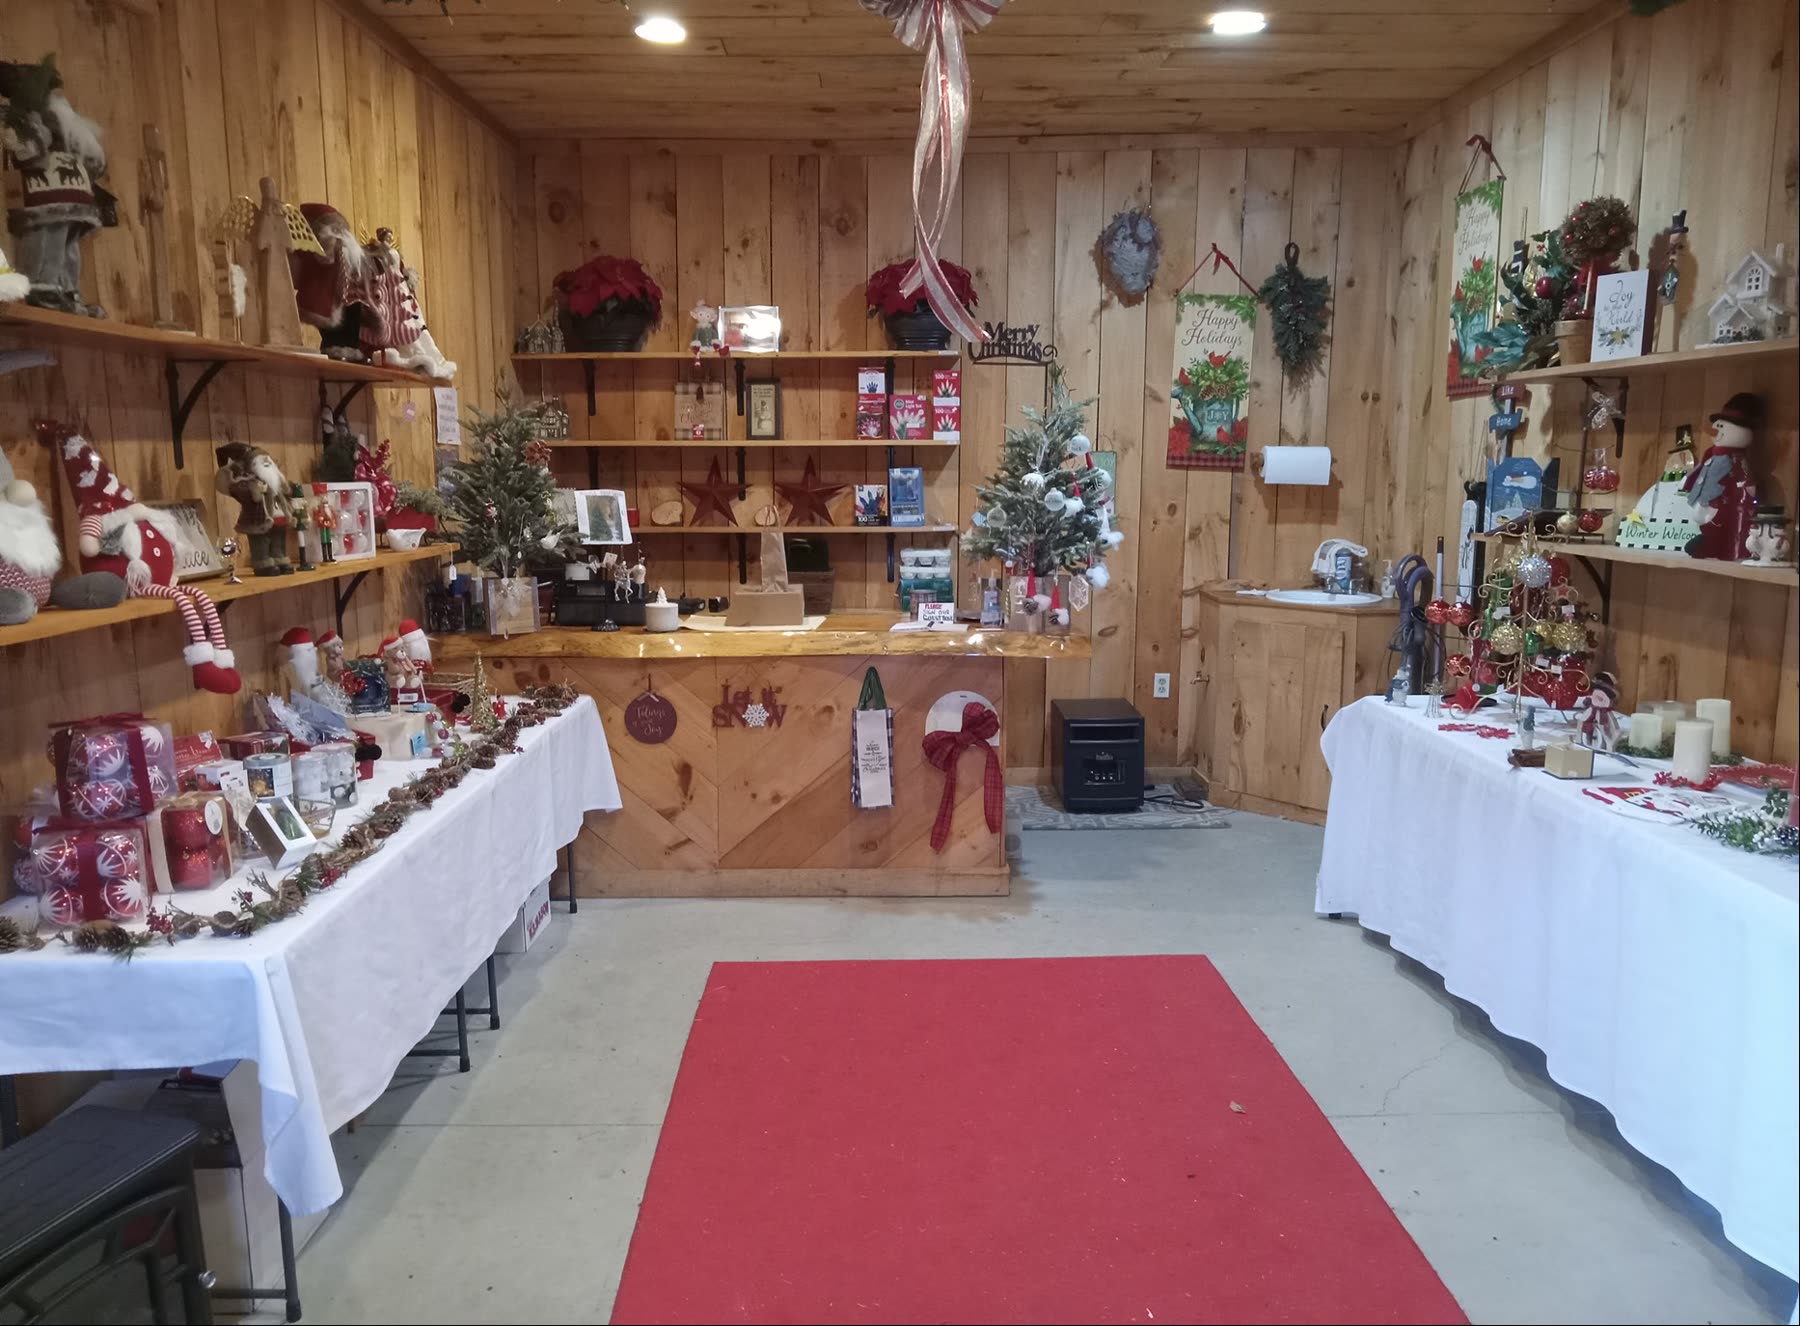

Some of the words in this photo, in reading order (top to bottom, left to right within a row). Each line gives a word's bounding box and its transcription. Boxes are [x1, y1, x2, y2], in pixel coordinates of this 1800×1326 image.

[1609, 280, 1633, 308] Joy
[1192, 309, 1239, 331] Happy
[983, 321, 1040, 343] Merry
[1181, 327, 1242, 349] Holidays
[967, 341, 1042, 362] Christmas
[1625, 525, 1659, 538] Winter
